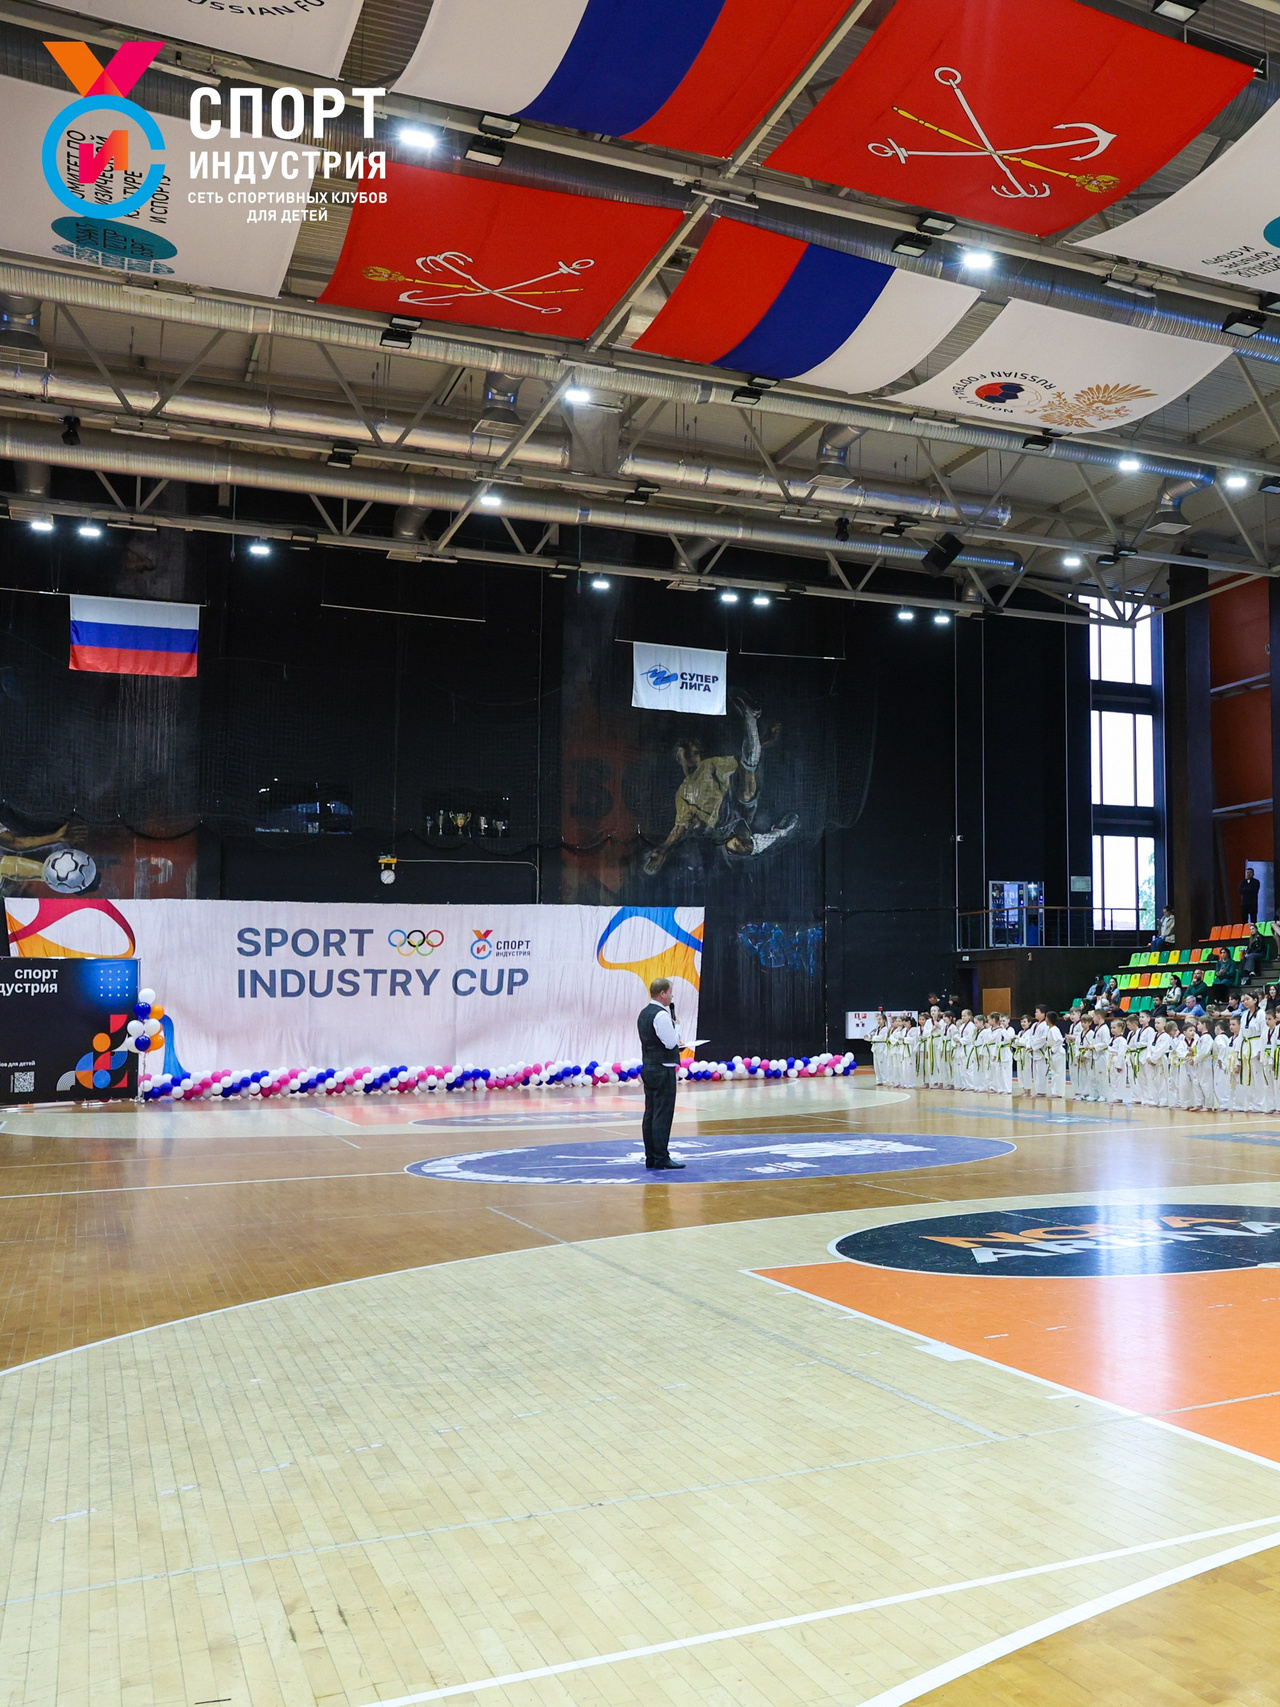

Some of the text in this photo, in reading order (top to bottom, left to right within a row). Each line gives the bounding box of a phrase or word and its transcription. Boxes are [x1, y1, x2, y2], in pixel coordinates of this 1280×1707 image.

[990, 371, 1056, 390] RUSSIAN
[680, 672, 719, 684] СУПЕР
[679, 682, 711, 692] ЛИГА
[236, 927, 374, 957] SPORT
[495, 940, 531, 951] СПОРТ
[495, 950, 531, 958] ИНДУСТРИЯ
[14, 968, 59, 982] спорт
[0, 983, 58, 997] дустрия
[237, 968, 529, 999] INDUSTRY CUP
[919, 1215, 1243, 1248] NOVA
